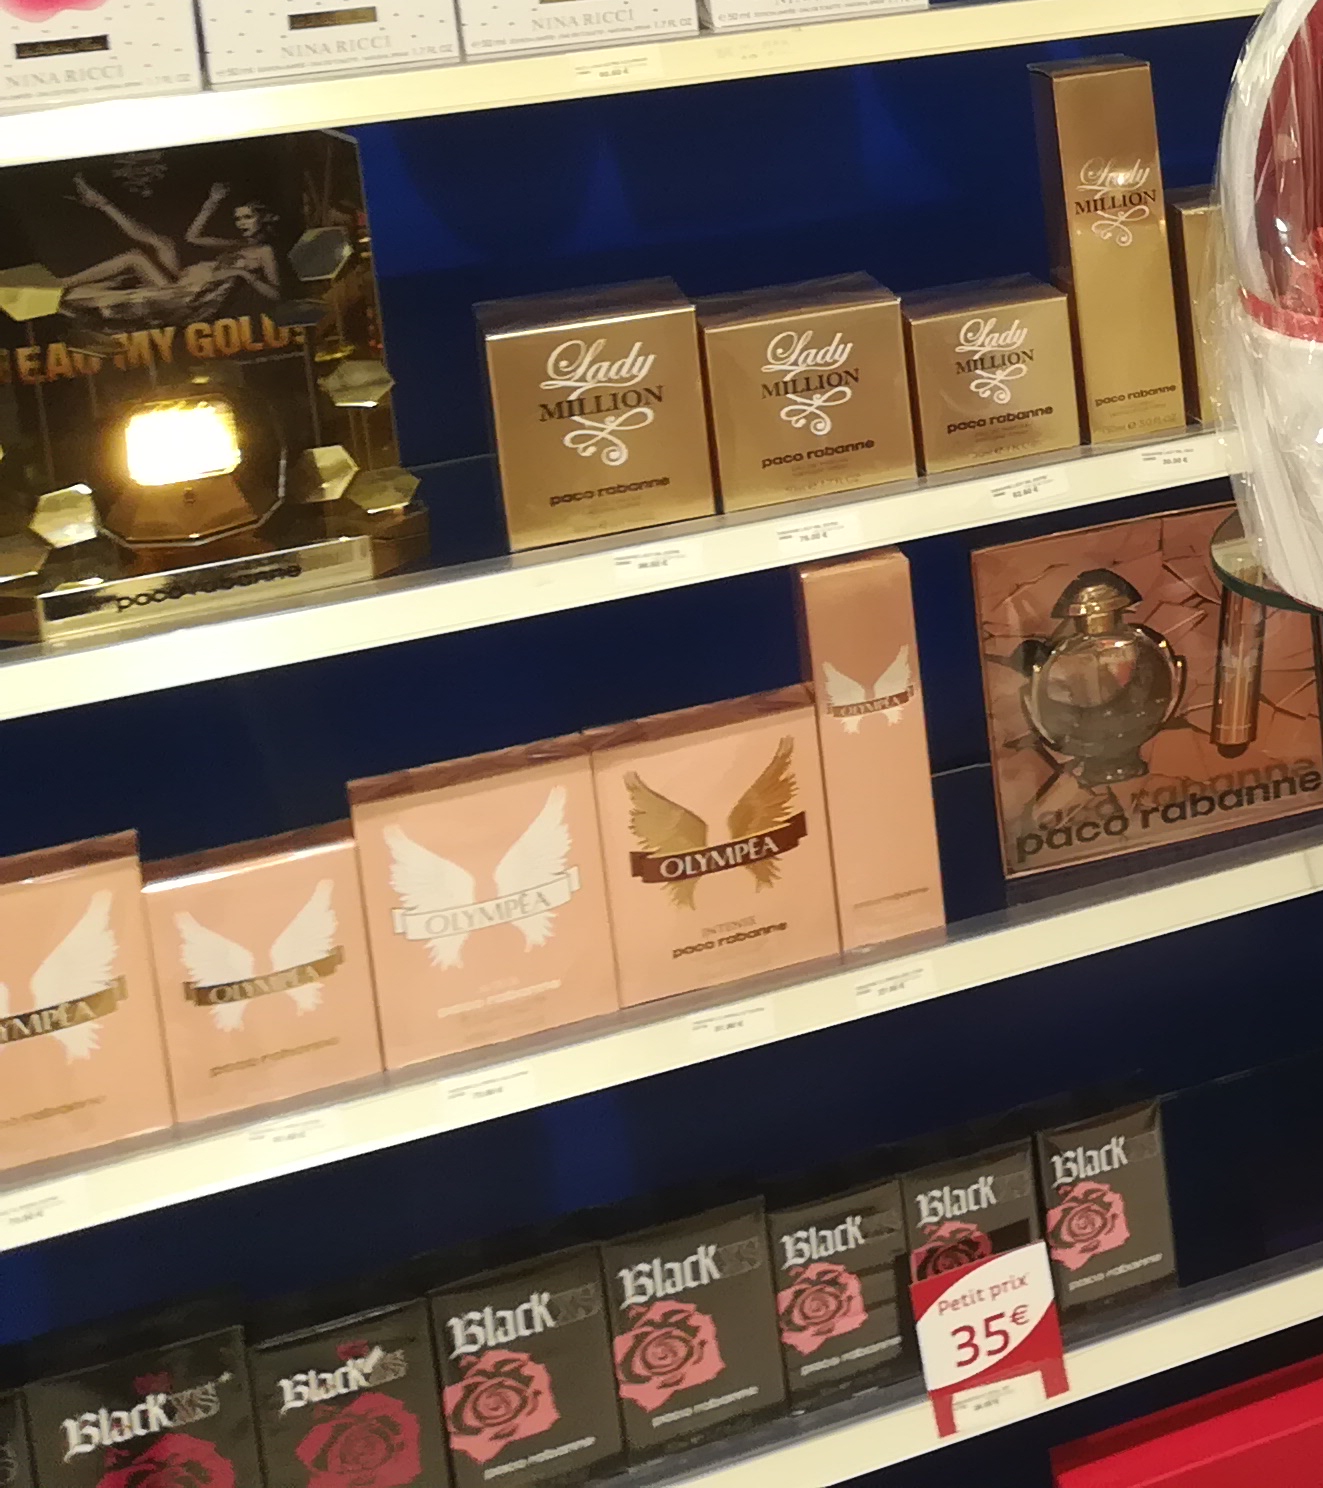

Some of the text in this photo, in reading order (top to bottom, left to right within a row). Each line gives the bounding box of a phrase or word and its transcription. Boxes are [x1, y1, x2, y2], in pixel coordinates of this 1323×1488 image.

[531, 8, 635, 31] NINA RICCI
[280, 35, 391, 59] NINA RICCI
[1074, 188, 1157, 216] MILLION
[760, 330, 854, 378] Lady
[955, 316, 1029, 357] Lady
[539, 338, 657, 396] Lady
[760, 367, 860, 399] MILLION
[955, 347, 1035, 376] MILLION
[538, 384, 665, 423] MILLION
[947, 405, 1054, 435] paco rabanne
[762, 437, 876, 470] paco rabanne
[549, 474, 671, 507] paco rabanne
[1016, 770, 1322, 864] paco rabanne
[1050, 1136, 1129, 1189] Black
[916, 1175, 998, 1229] Black
[780, 1215, 865, 1270] Black
[617, 1244, 722, 1310] Black
[938, 1272, 1031, 1318] Petit prix
[446, 1293, 556, 1360] Black
[951, 1303, 1031, 1368] 35€
[277, 1352, 374, 1417] Black
[61, 1392, 173, 1464] Black
